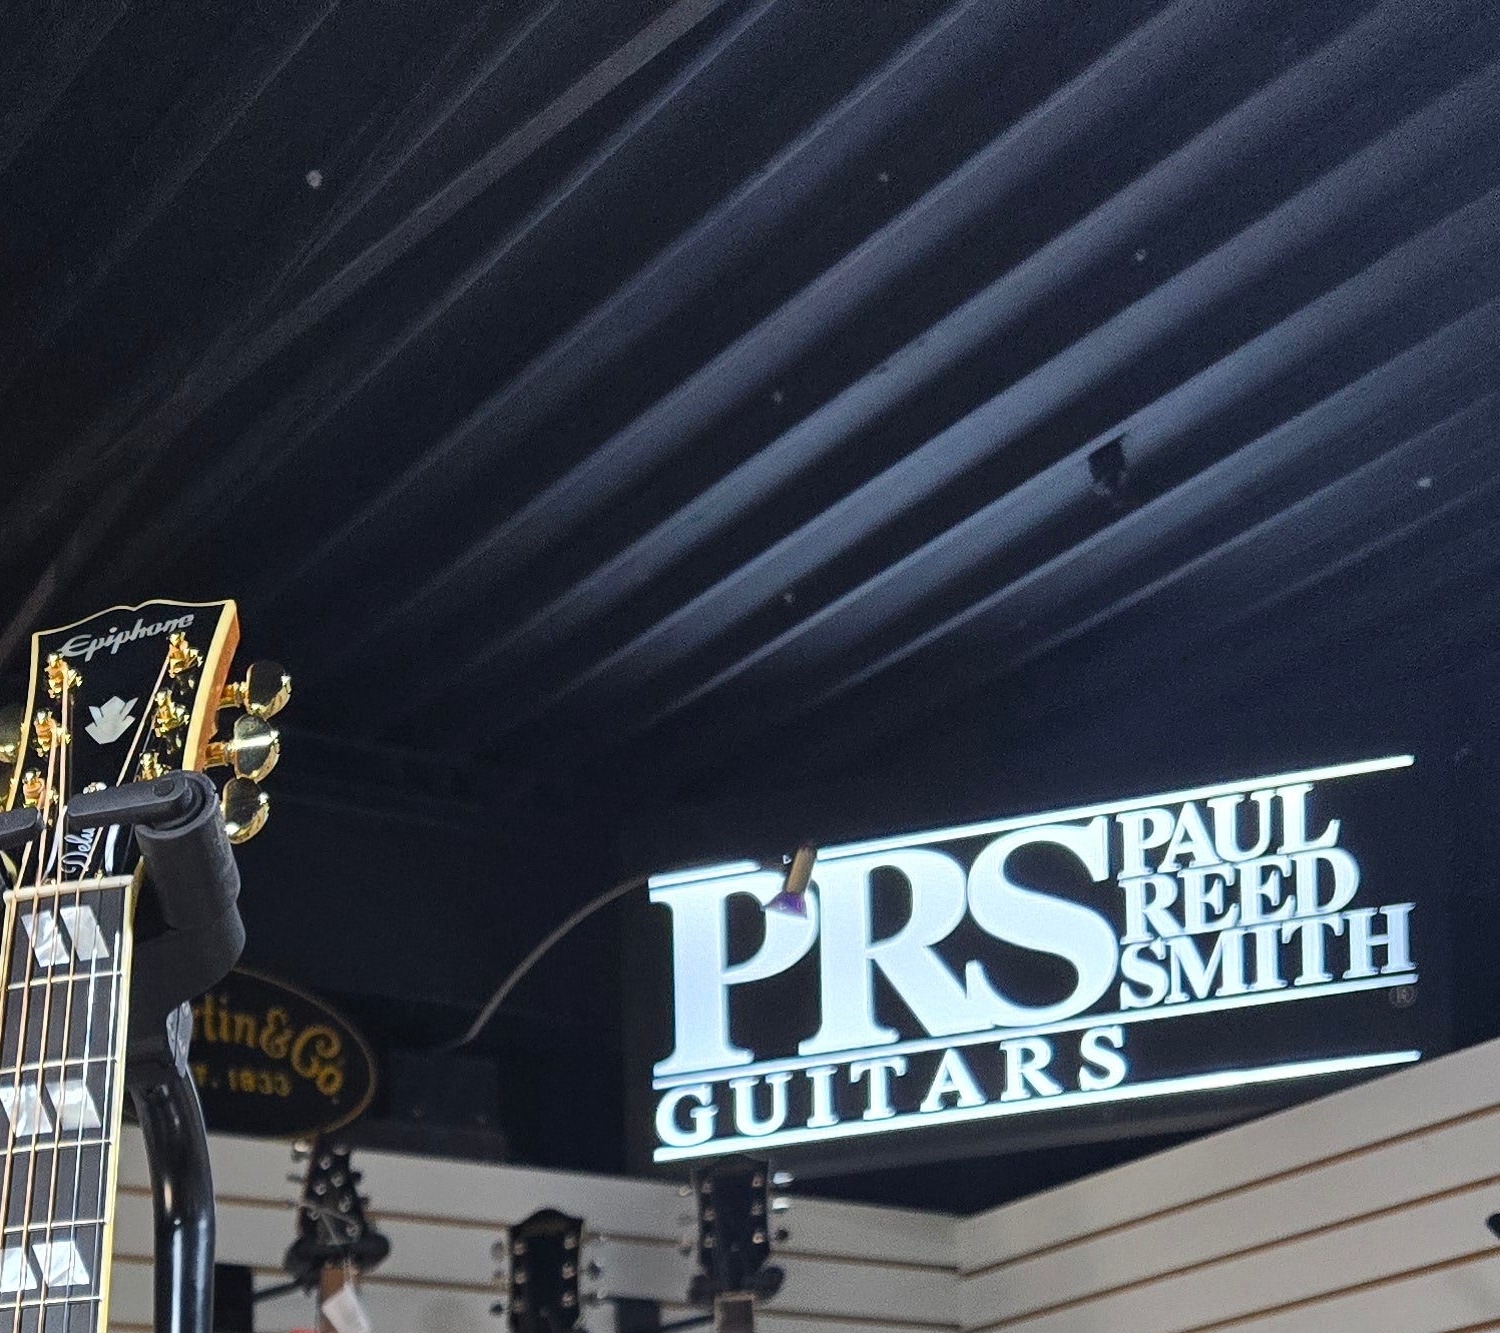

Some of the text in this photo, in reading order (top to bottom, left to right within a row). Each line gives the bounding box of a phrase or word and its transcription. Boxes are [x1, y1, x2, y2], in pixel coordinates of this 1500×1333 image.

[62, 613, 194, 662] Epiphone
[60, 827, 96, 874] Delu
[1117, 783, 1340, 880] PAUL
[650, 815, 1118, 1074] PRS
[1118, 847, 1360, 946] REED
[1120, 902, 1416, 1011] SMITH
[655, 1025, 1130, 1148] GUITARS
